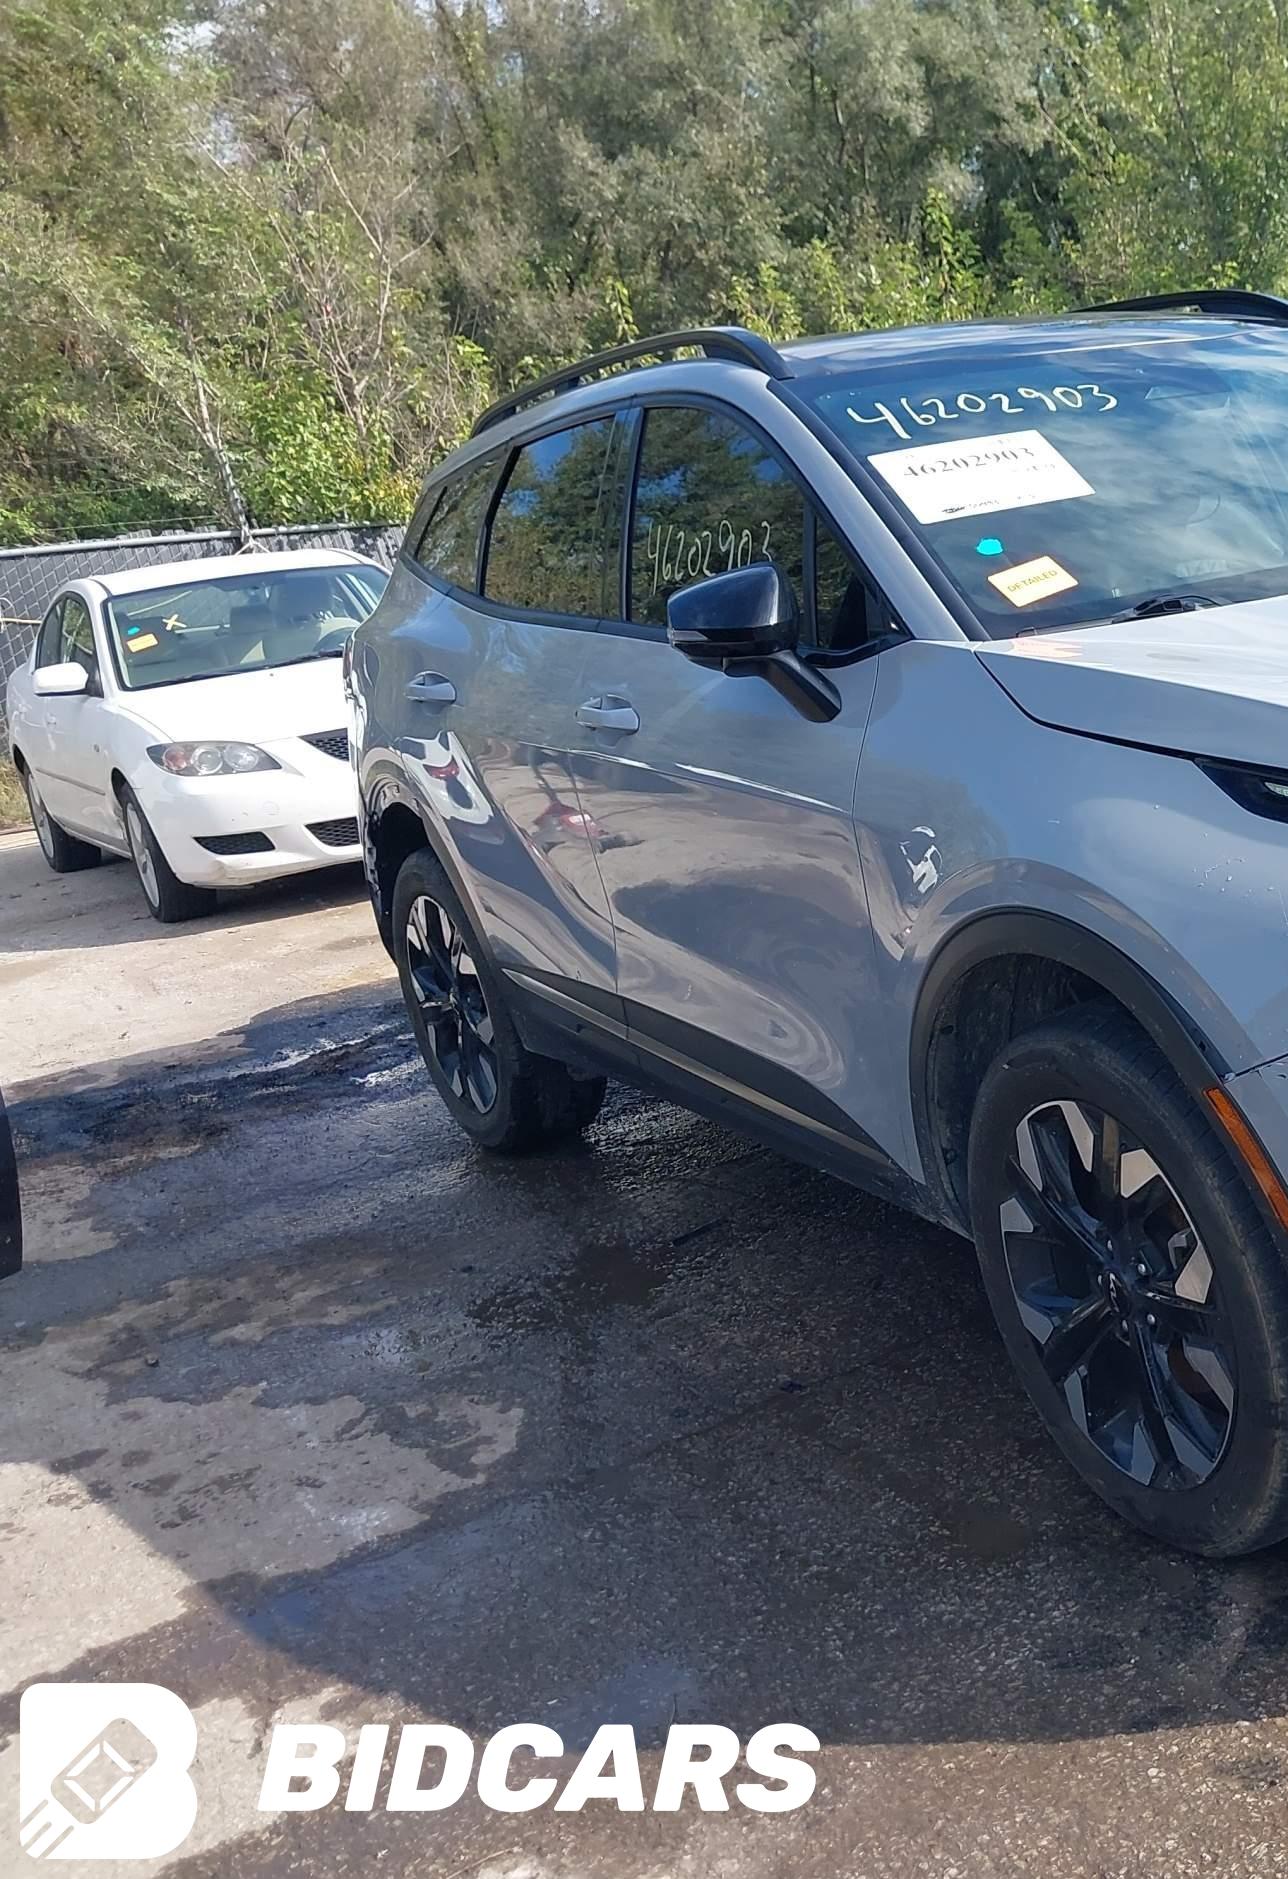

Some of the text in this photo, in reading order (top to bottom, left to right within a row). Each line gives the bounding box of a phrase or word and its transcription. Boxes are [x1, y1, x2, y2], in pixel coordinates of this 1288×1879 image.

[846, 384, 1118, 440] 46202903
[902, 446, 1035, 479] 46202903
[1006, 569, 1059, 594] DETAILED
